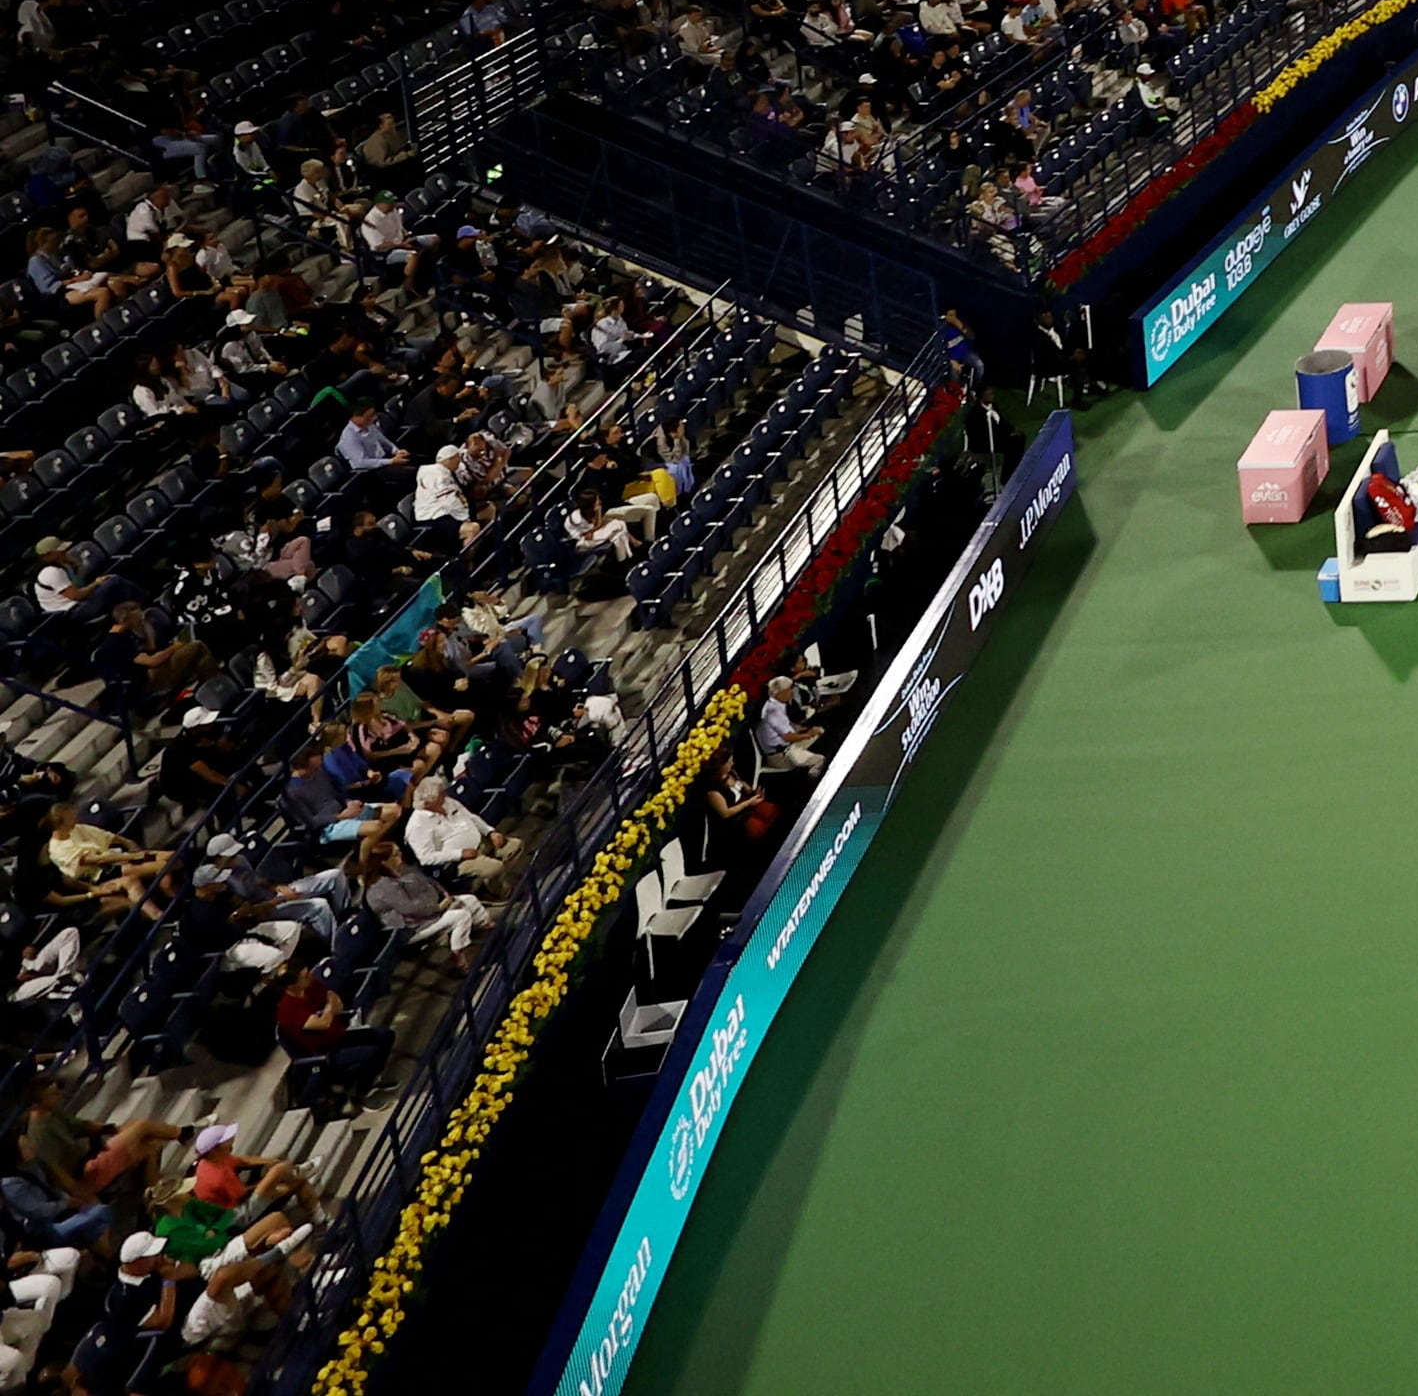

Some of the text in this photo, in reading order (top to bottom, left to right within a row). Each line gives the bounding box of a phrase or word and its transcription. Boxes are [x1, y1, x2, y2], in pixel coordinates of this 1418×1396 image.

[1171, 272, 1216, 327] Dubai
[1173, 294, 1217, 343] Duty Free
[1019, 453, 1072, 550] J.P.Morgan
[1250, 491, 1288, 503] evian
[969, 557, 1004, 632] DXB
[909, 678, 931, 718] Win
[766, 801, 862, 971] WTATENNIS.COM
[688, 993, 748, 1125] Dubai
[693, 1027, 748, 1150] Duty Free
